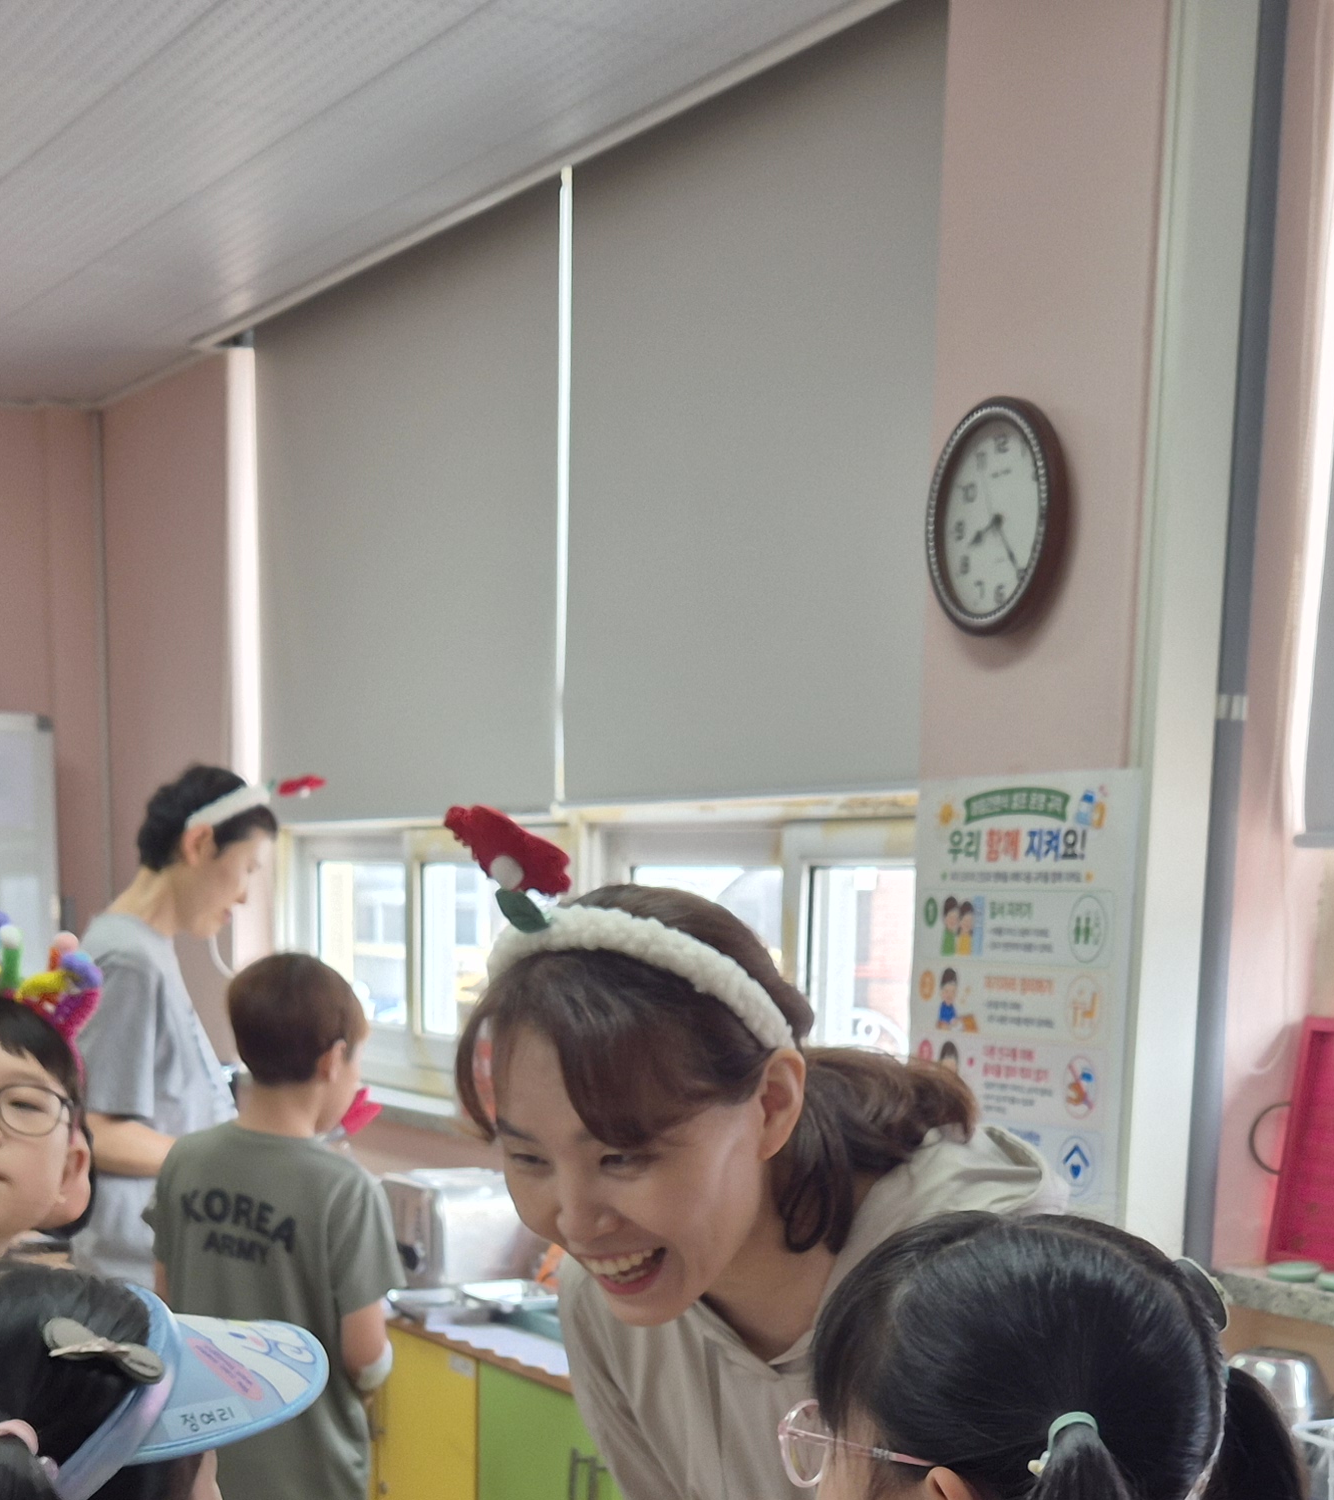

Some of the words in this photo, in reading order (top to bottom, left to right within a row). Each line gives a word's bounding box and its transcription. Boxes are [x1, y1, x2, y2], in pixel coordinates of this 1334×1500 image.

[948, 828, 982, 862] 우리
[985, 827, 1021, 863] 함께
[1024, 827, 1087, 862] 지켜요!
[181, 1188, 297, 1254] KOREA
